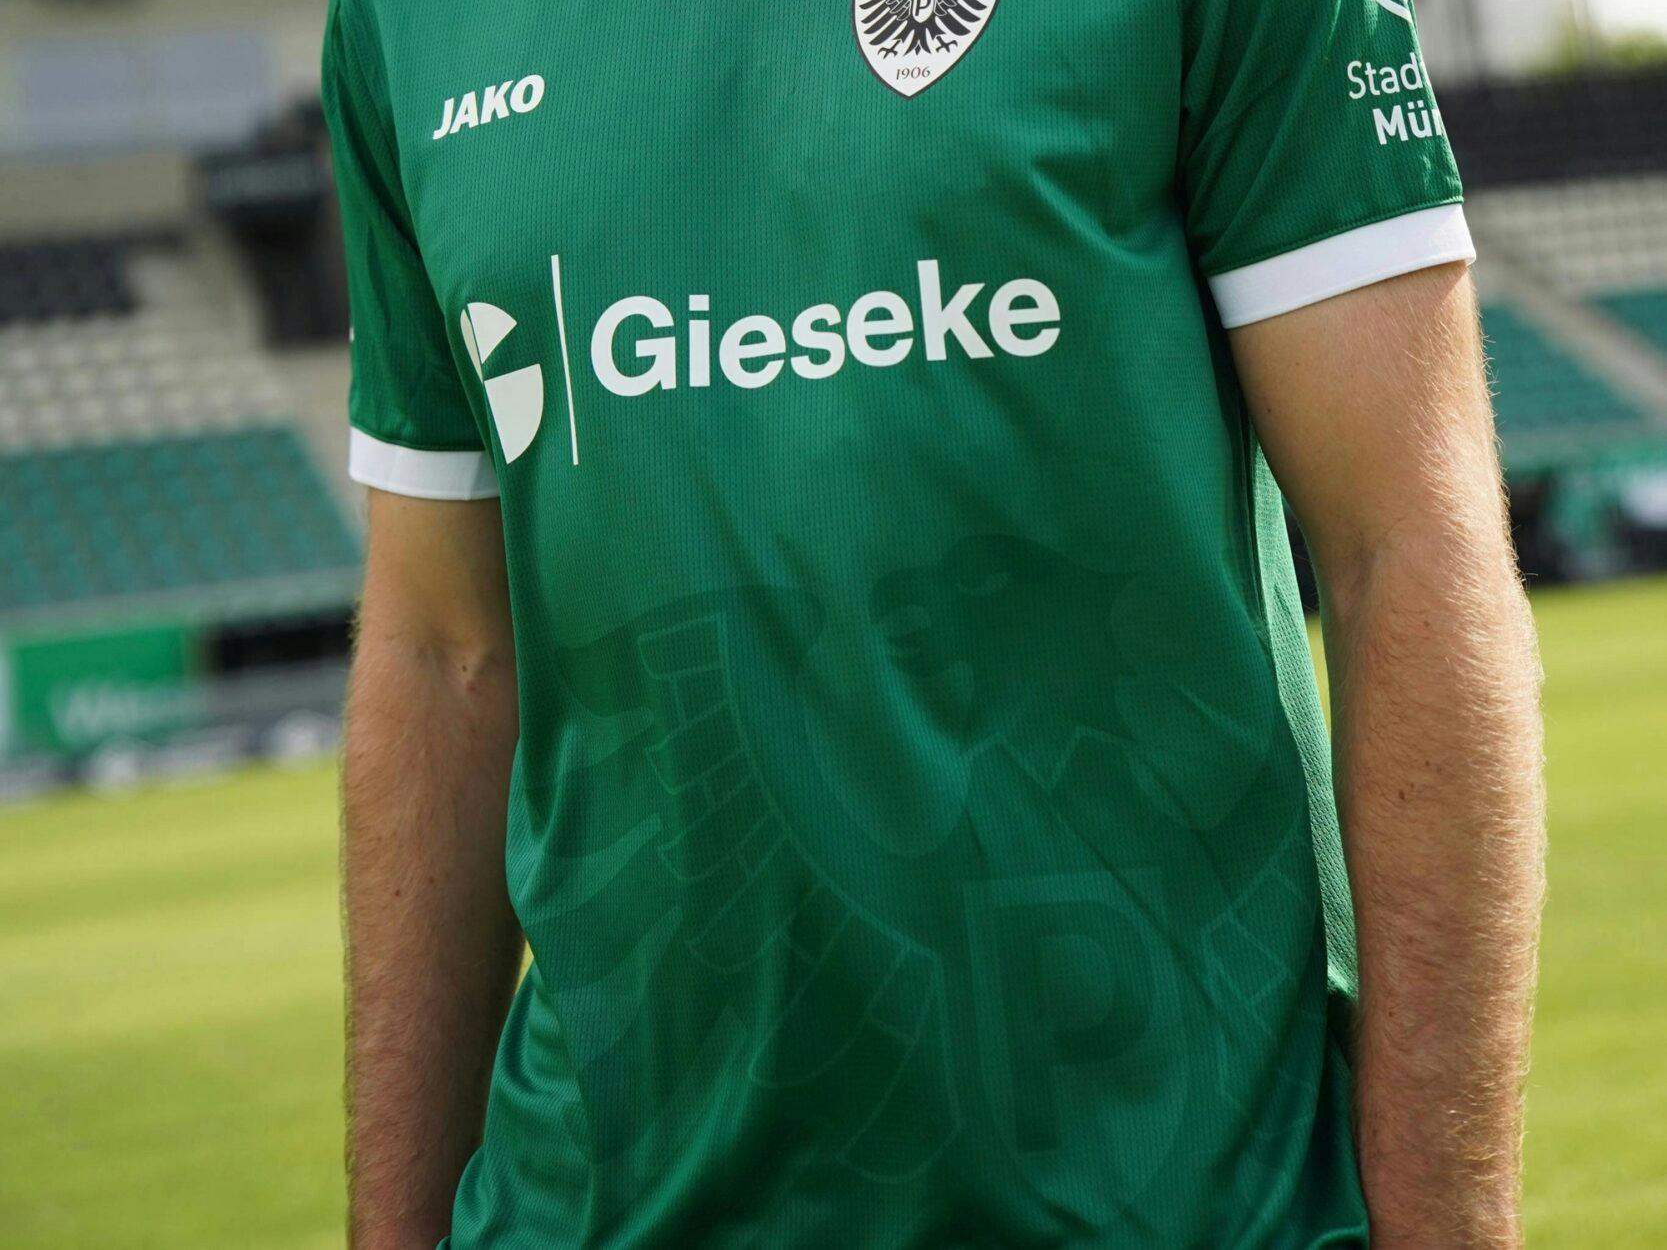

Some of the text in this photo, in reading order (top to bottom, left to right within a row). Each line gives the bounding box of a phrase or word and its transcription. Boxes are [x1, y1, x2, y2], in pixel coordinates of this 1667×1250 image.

[896, 66, 931, 80] 1906
[433, 74, 546, 140] JAKO
[590, 259, 1061, 397] Gieseke
